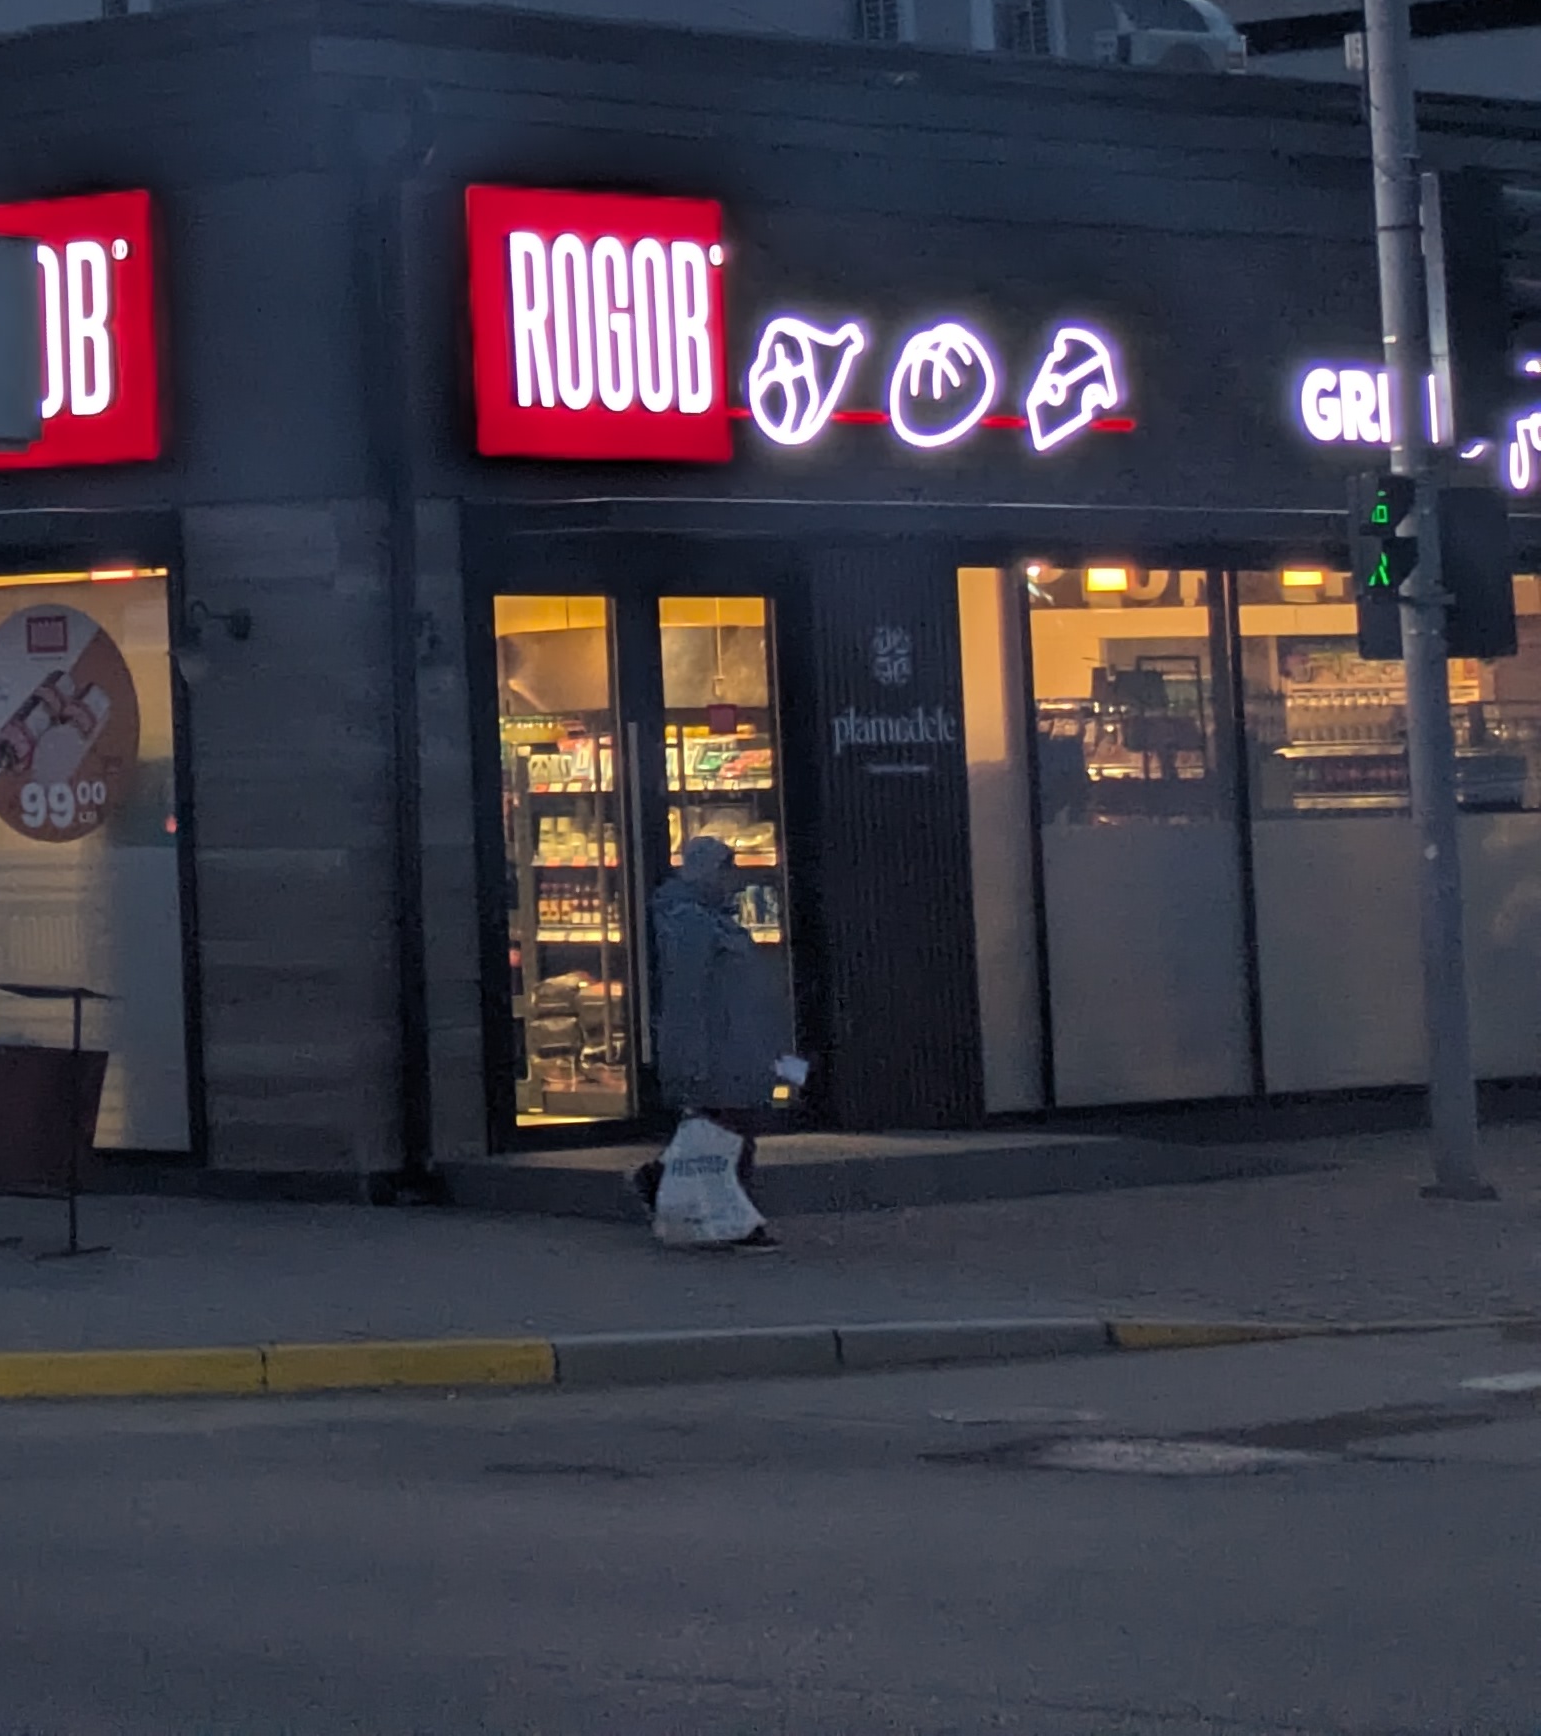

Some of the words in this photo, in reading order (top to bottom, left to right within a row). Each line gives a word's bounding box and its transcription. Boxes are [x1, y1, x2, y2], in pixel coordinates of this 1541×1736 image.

[508, 230, 715, 415] ROGOB
[19, 780, 75, 830] 99
[76, 780, 106, 805] 00
